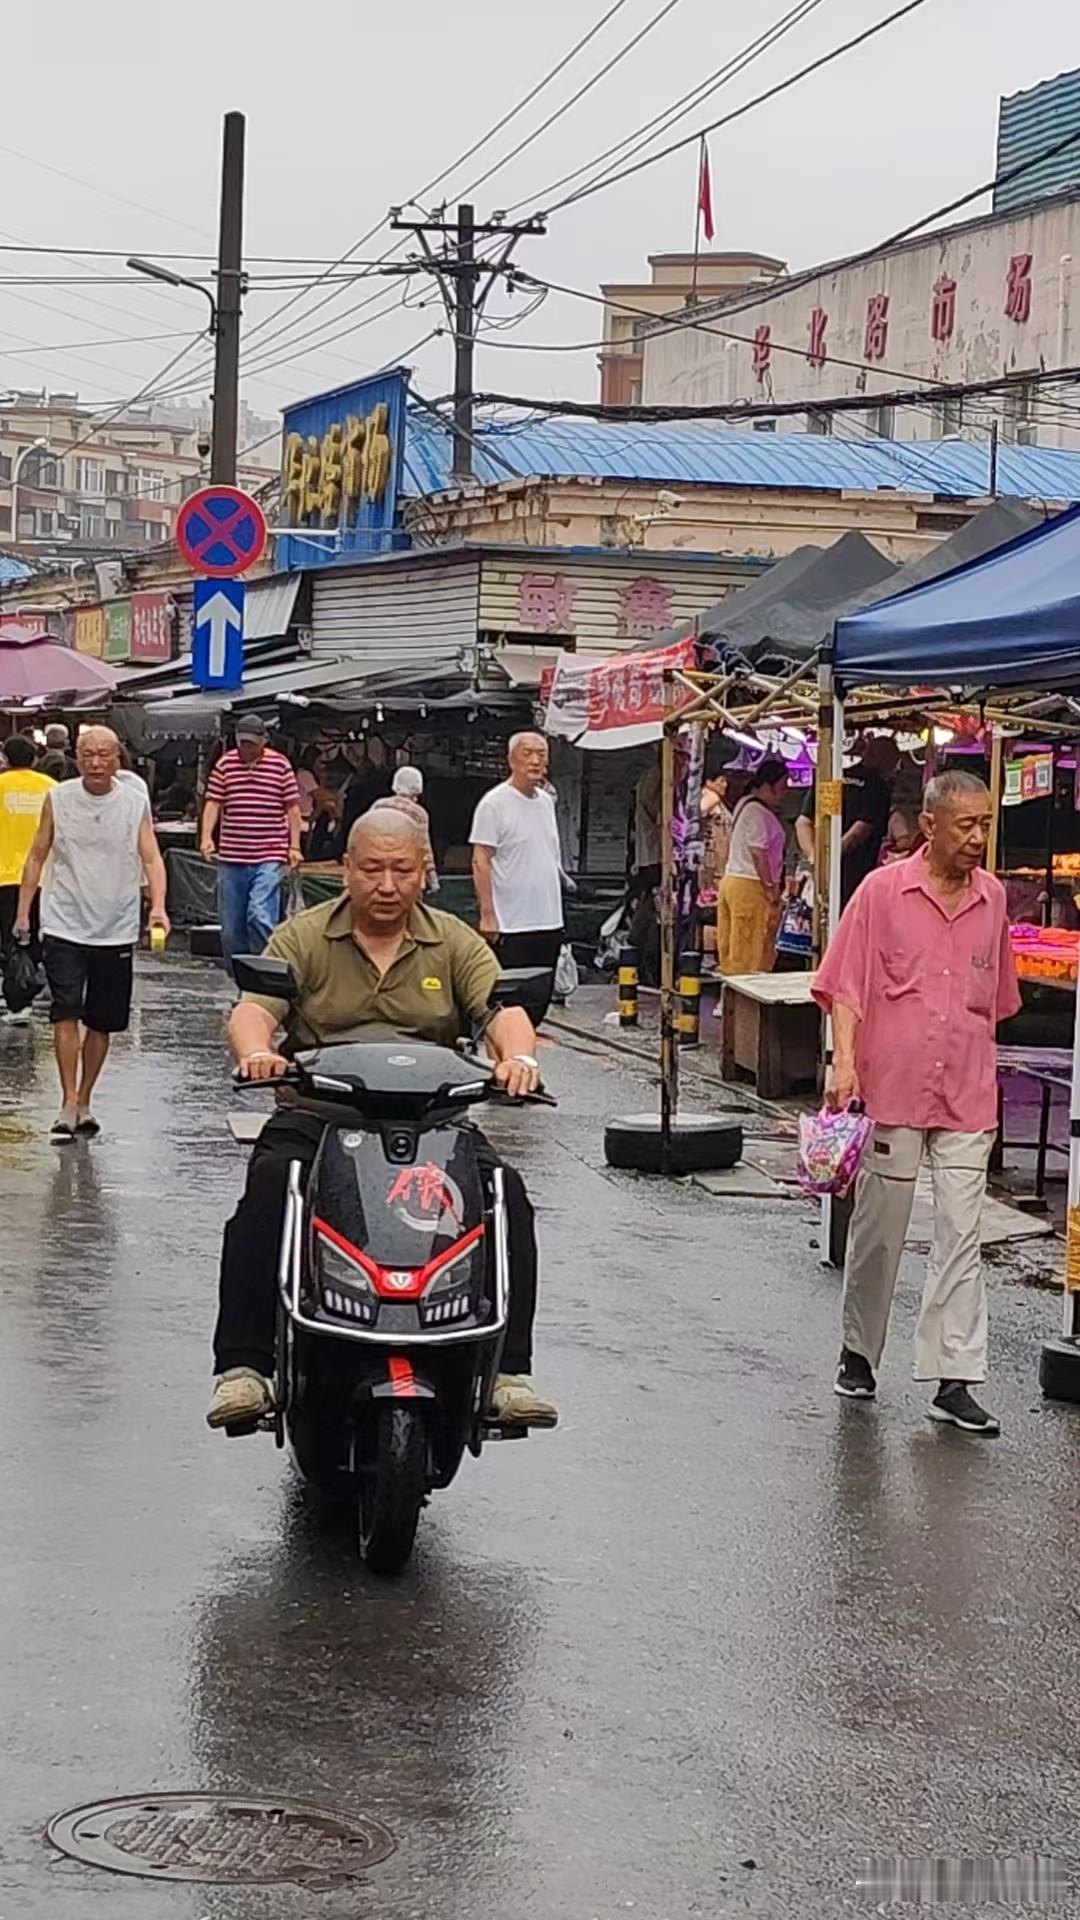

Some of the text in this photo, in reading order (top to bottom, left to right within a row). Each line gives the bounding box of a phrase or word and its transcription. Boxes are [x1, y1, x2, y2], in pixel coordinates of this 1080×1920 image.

[752, 253, 1033, 383] 华北路市场
